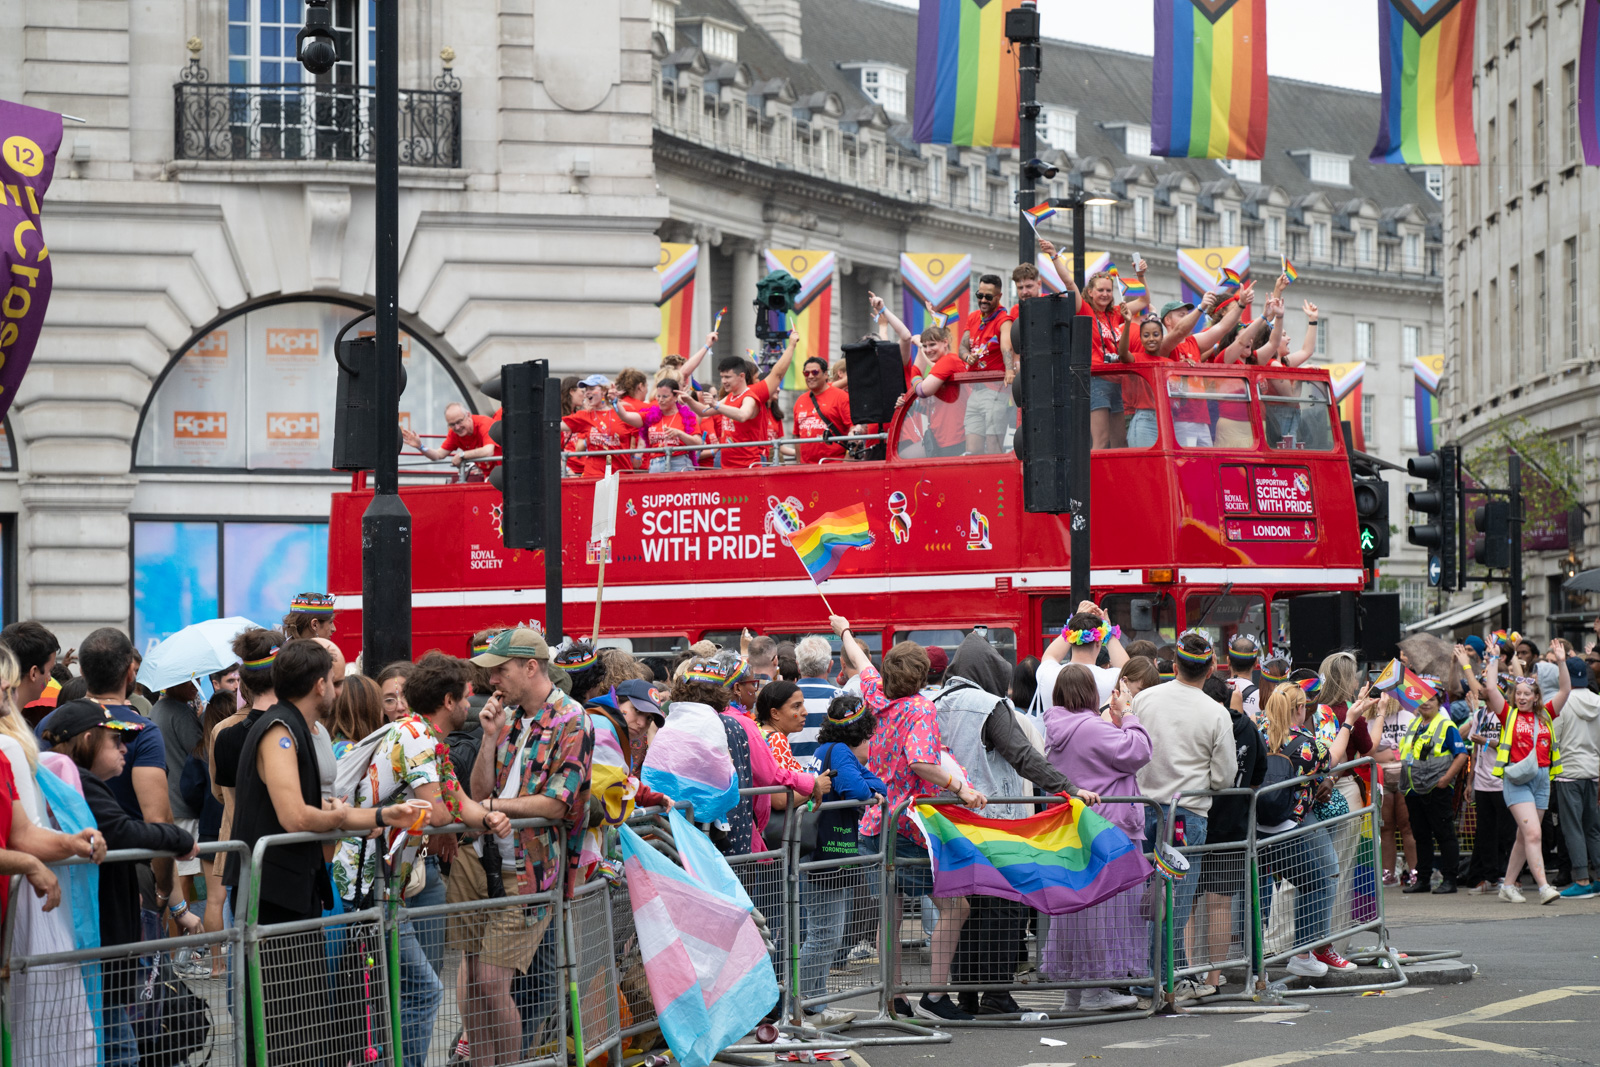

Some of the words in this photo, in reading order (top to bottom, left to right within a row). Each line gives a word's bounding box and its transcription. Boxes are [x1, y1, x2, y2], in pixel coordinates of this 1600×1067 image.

[13, 145, 35, 167] 12
[269, 333, 317, 352] KpH
[176, 416, 225, 436] KpH
[269, 417, 318, 437] KpH
[1256, 478, 1288, 486] SUPPORTING
[642, 492, 720, 508] SUPPORTING
[1257, 486, 1297, 499] SCIENCE
[1258, 499, 1283, 512] WITH
[1284, 501, 1313, 513] PRIDE
[642, 507, 741, 535] SCIENCE
[1253, 525, 1291, 537] LONDON
[471, 550, 496, 560] ROYAL
[641, 537, 704, 563] WITH
[708, 534, 776, 560] PRIDE
[470, 559, 503, 570] SOCIETY
